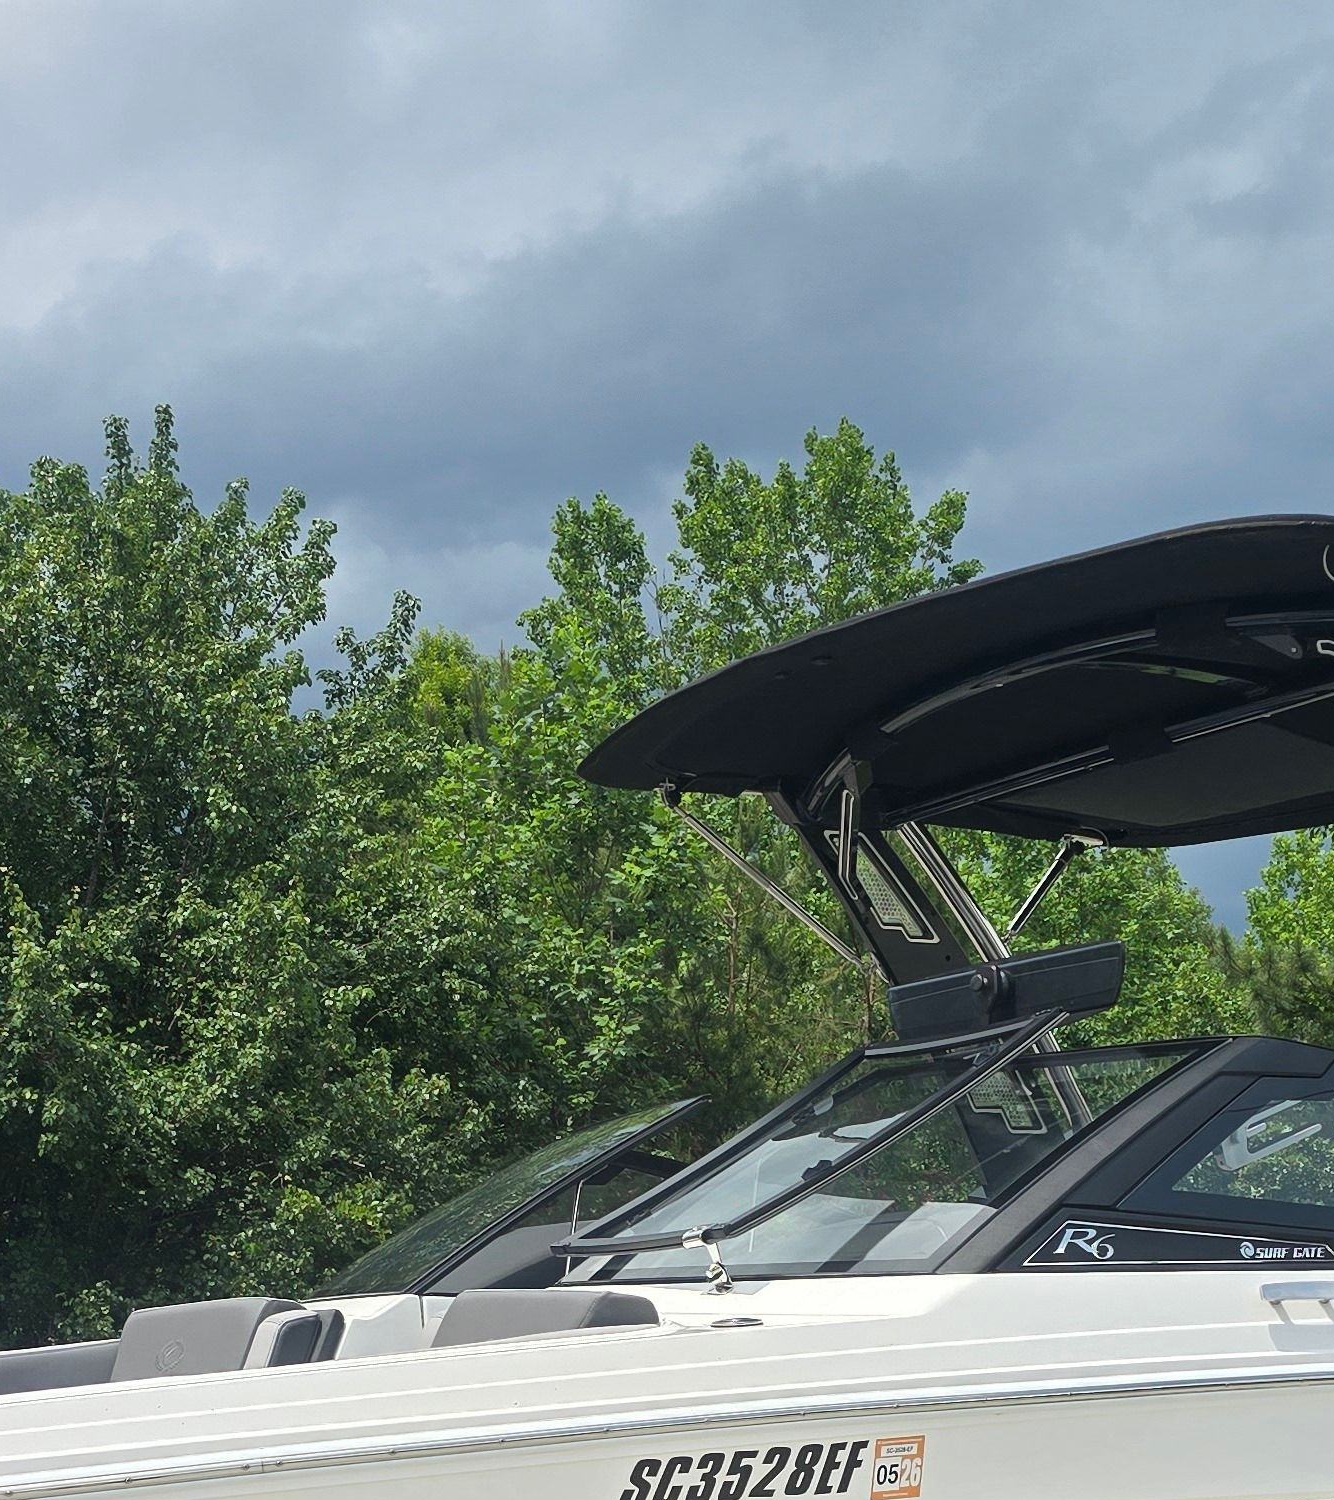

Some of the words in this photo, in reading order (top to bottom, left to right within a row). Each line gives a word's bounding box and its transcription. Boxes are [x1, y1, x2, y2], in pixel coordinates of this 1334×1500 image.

[1053, 1228, 1115, 1260] R6
[1255, 1246, 1289, 1259] SURF
[1294, 1245, 1326, 1259] GATE
[877, 1463, 899, 1485] 05
